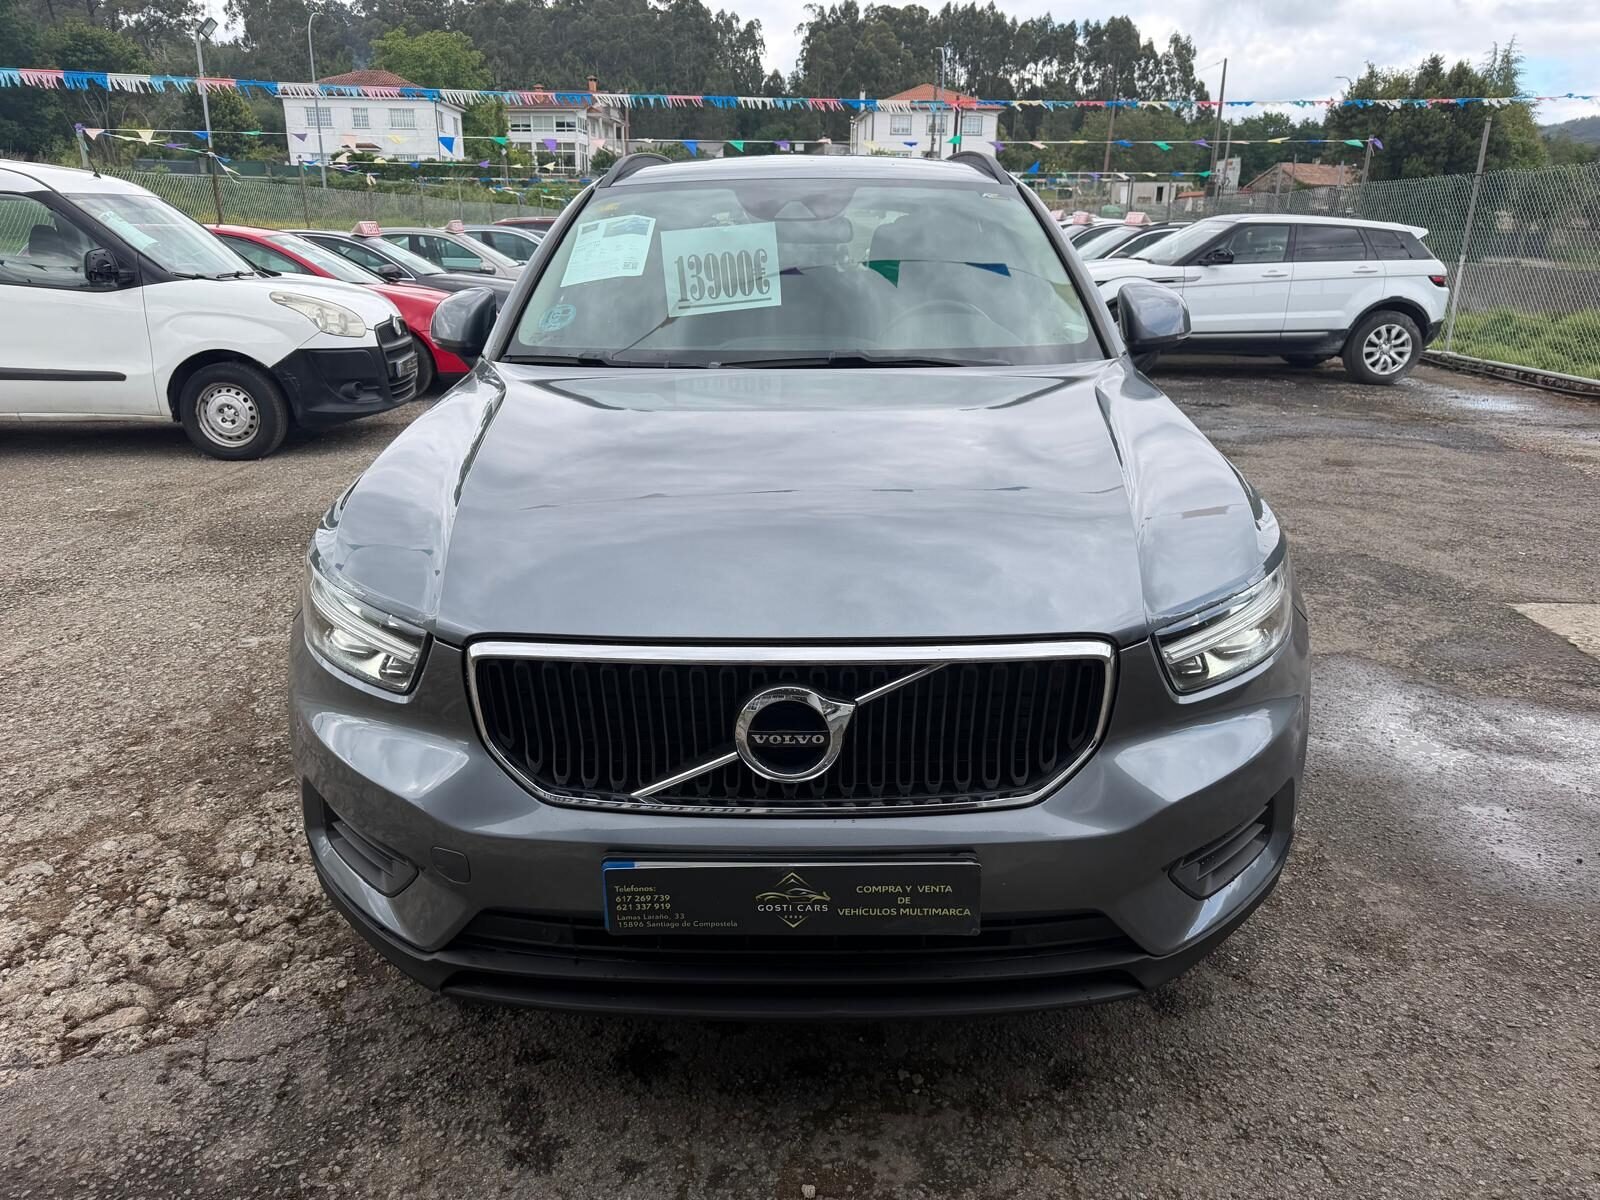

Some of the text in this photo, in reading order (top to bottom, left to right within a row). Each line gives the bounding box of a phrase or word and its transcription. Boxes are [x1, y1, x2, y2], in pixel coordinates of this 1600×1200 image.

[674, 248, 770, 302] 13900€
[751, 734, 824, 744] VOLVO
[856, 885, 953, 893] COMPRA Y VENTA
[897, 896, 911, 904] DE
[757, 904, 829, 912] GOSTI CARS
[837, 906, 971, 916] VEHÍCULOS MULTIMARCA
[646, 920, 679, 929] Santiago
[693, 920, 738, 929] Compostela
